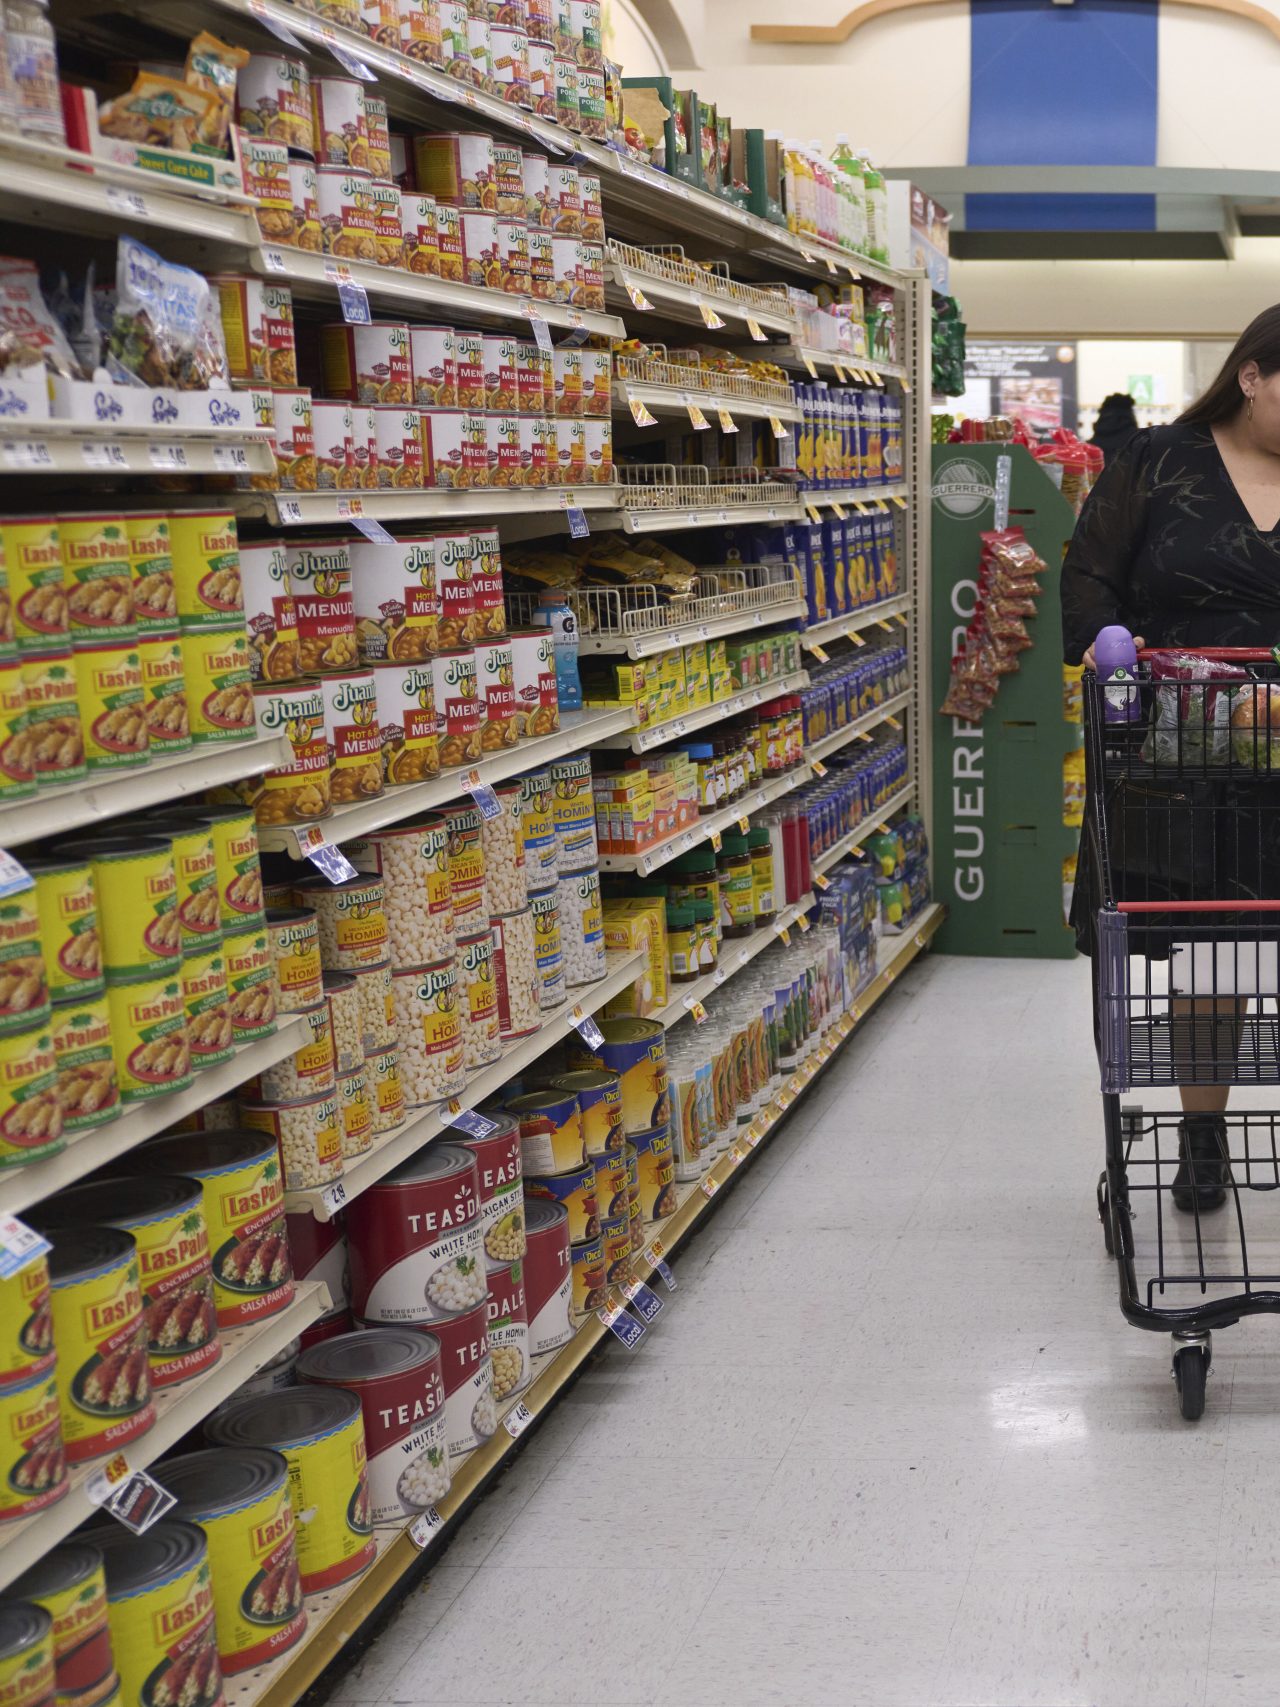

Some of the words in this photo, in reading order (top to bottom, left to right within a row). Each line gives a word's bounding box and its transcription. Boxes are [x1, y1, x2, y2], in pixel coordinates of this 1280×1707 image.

[931, 483, 994, 497] GUERRERO
[562, 617, 575, 633] G
[450, 863, 484, 880] OMINY
[483, 1157, 520, 1188] EASD
[331, 1183, 347, 1204] 2.19
[228, 1192, 260, 1218] Las
[430, 1236, 465, 1260] WHITE
[140, 1244, 177, 1274] Las
[241, 1300, 266, 1315] SALSA
[622, 1327, 641, 1347] Local
[153, 1361, 183, 1378] SALSA
[401, 1426, 434, 1455] WHITE
[425, 1508, 442, 1529] 4.49
